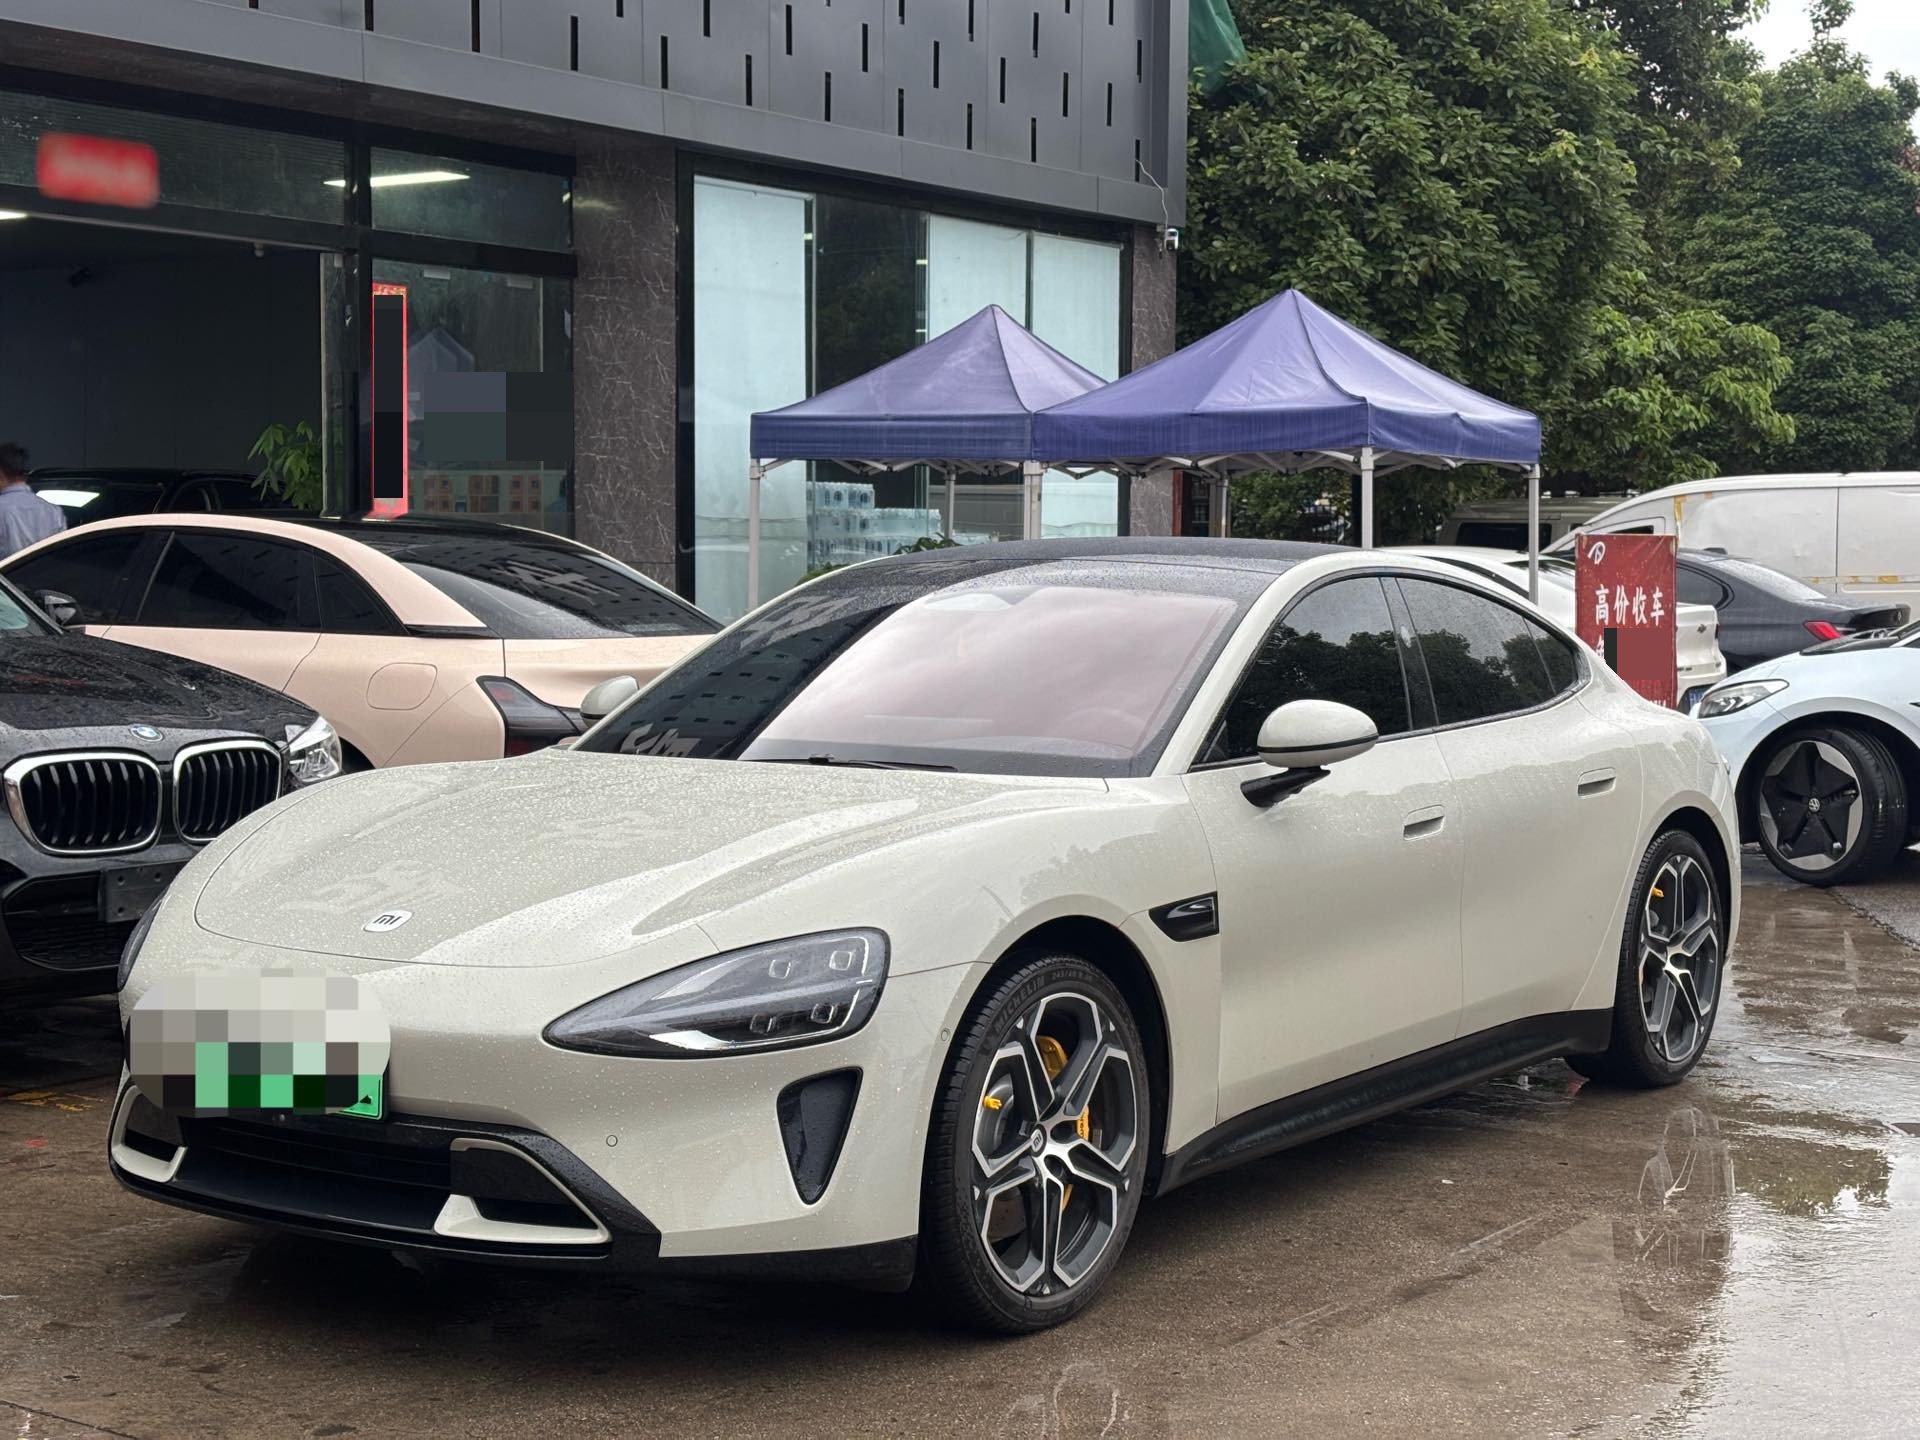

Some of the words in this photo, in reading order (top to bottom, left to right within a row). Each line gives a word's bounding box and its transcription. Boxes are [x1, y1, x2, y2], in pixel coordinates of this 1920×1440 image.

[1595, 584, 1665, 626] 高价收车
[993, 975, 1046, 1034] MICHELIN
